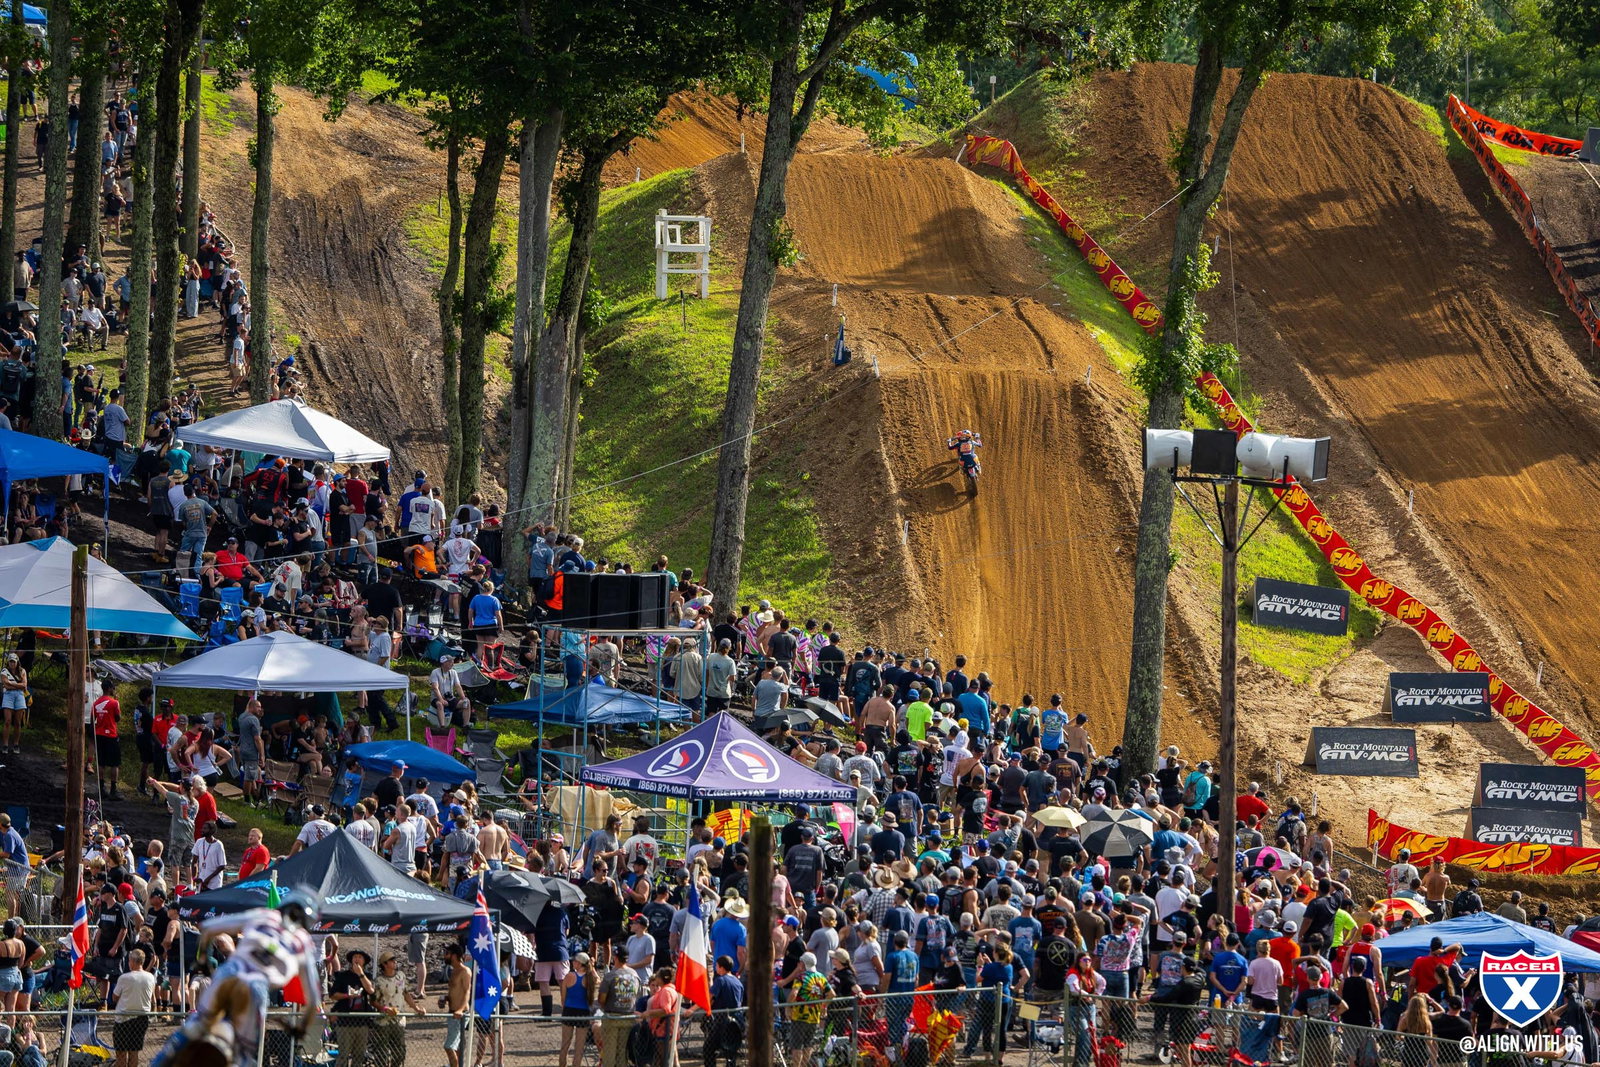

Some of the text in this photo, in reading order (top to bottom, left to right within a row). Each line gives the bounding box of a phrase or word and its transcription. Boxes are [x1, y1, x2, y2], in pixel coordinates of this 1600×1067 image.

[1502, 130, 1535, 151] KTM
[1307, 519, 1334, 539] FMF
[1330, 550, 1364, 571] FMF
[1361, 580, 1394, 600] FMF
[1397, 601, 1427, 621] FMF
[1426, 625, 1455, 643] FMF
[1453, 652, 1482, 671] FMF
[1503, 697, 1530, 718] FMF
[1528, 720, 1564, 738] FMF
[1552, 744, 1594, 760] FMF
[1391, 832, 1450, 861] FMF
[1451, 843, 1550, 871] FMF
